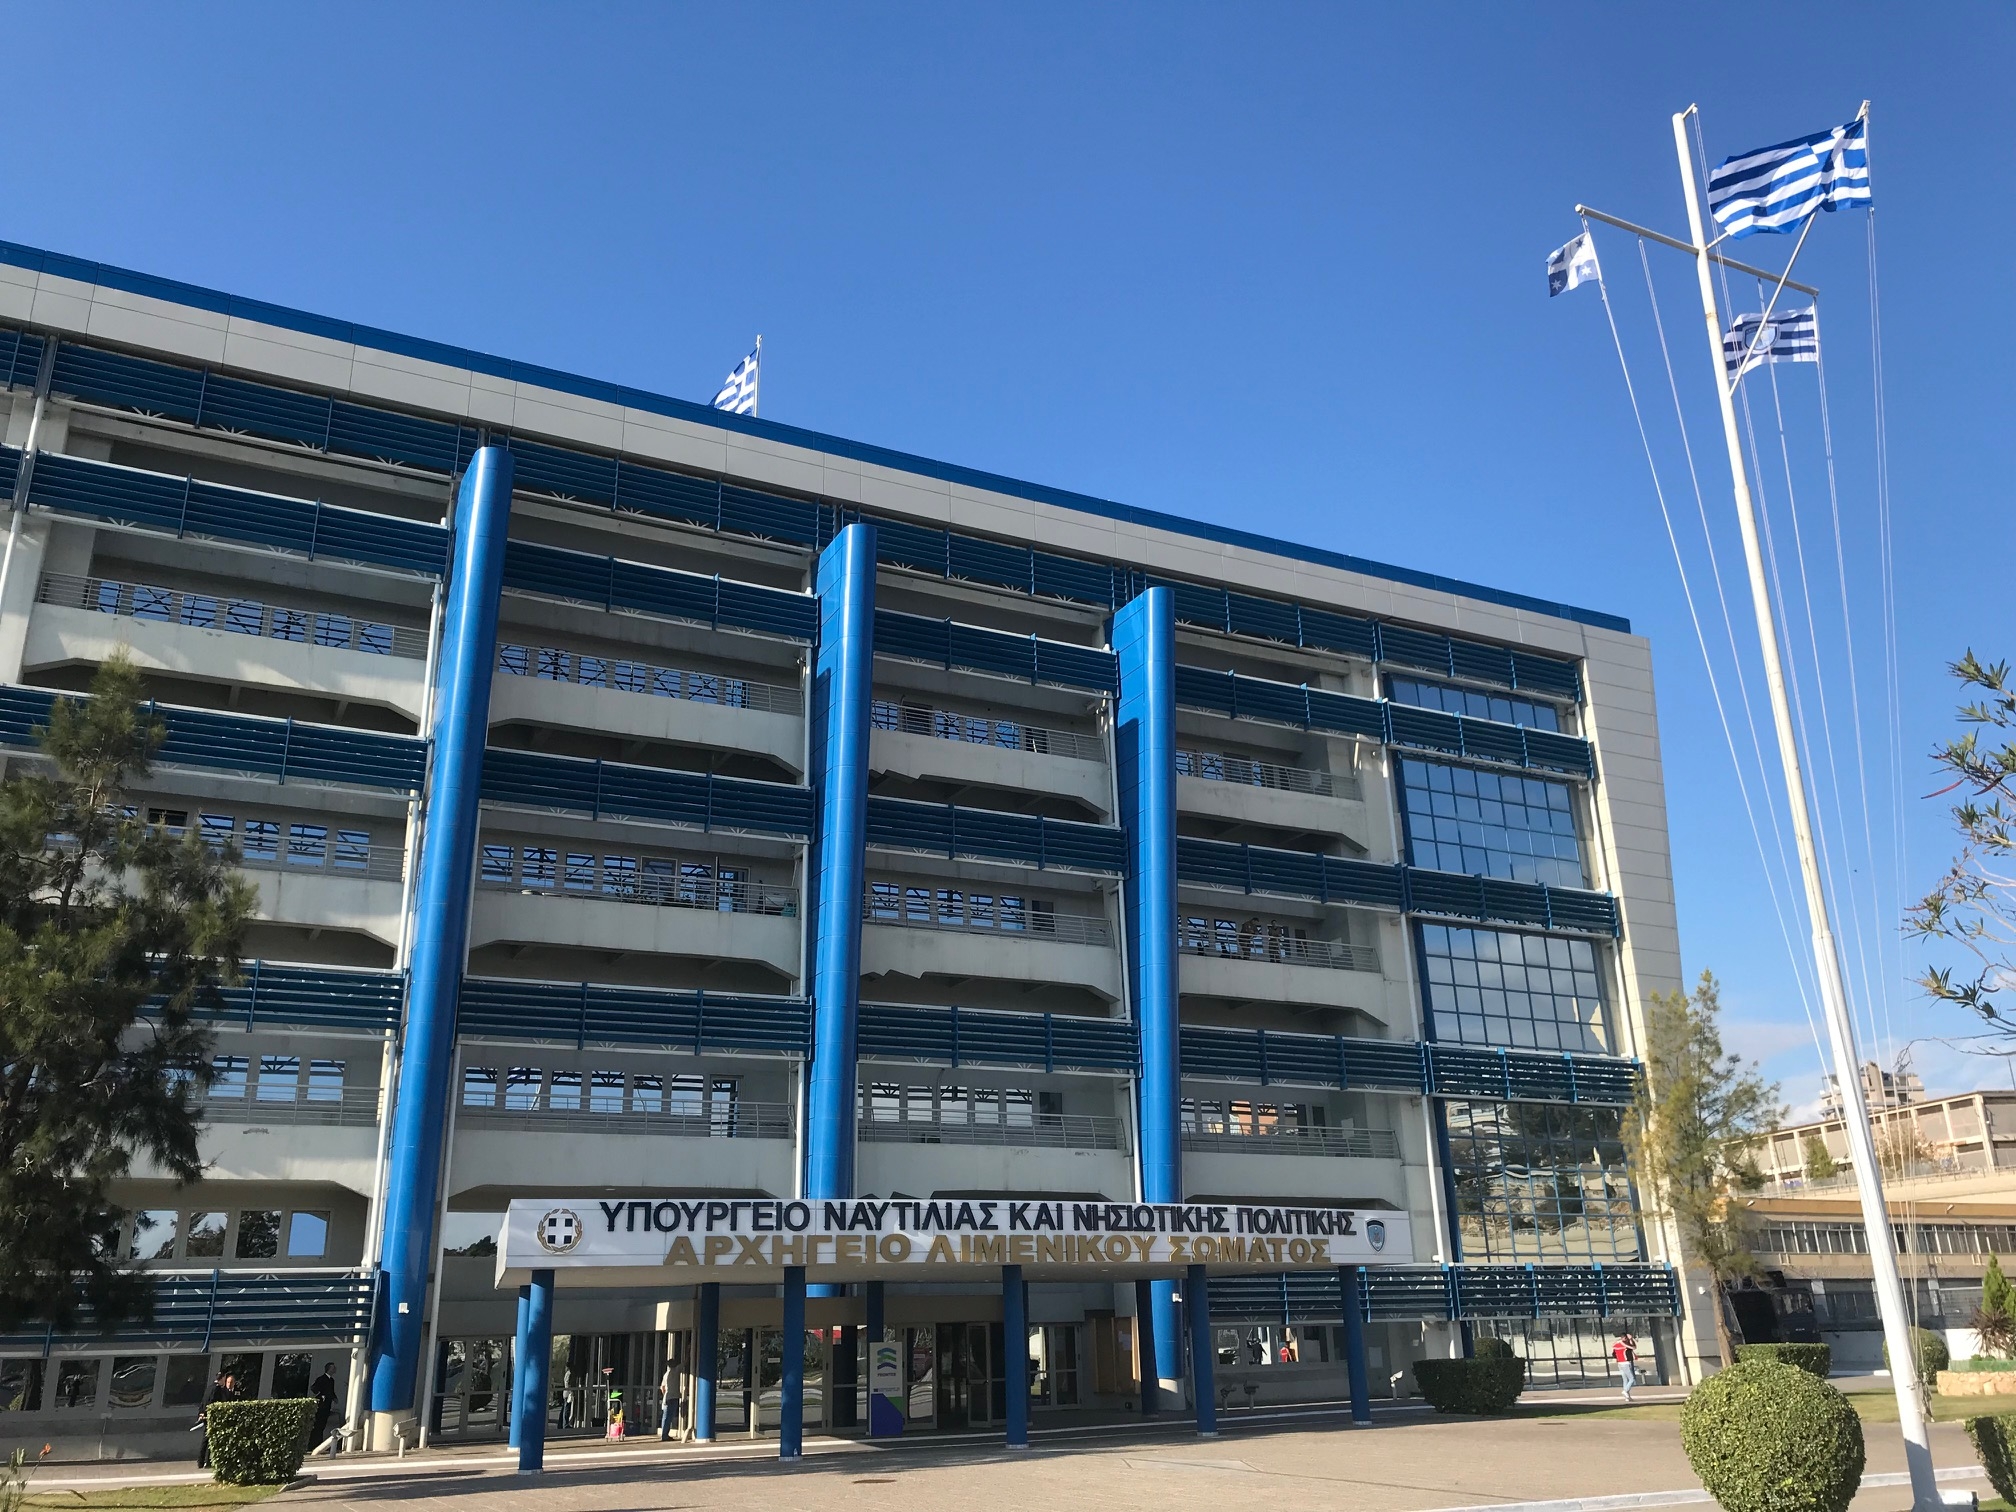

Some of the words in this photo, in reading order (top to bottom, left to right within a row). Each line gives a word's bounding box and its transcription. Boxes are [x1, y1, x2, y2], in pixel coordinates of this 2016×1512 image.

[600, 1201, 811, 1232] ΥΠΟΥΡΓΕΙΟ
[823, 1202, 998, 1231] ΝΑΥΤΙΛΙΑΣ
[1009, 1202, 1063, 1231] ΚΑΙ
[1073, 1203, 1230, 1233] ΝΗΣΙΩΤΙΚΗΣ
[1237, 1207, 1357, 1236] ΠΟΛΙΤΙΚΗΣ
[664, 1235, 911, 1266] ΑΡΧΗΓΕΙΟ
[925, 1234, 1158, 1264] ΛΙΜΕΝΙΚΟΥ
[1167, 1236, 1331, 1264] ΣΩΜΑΤΟΣ
